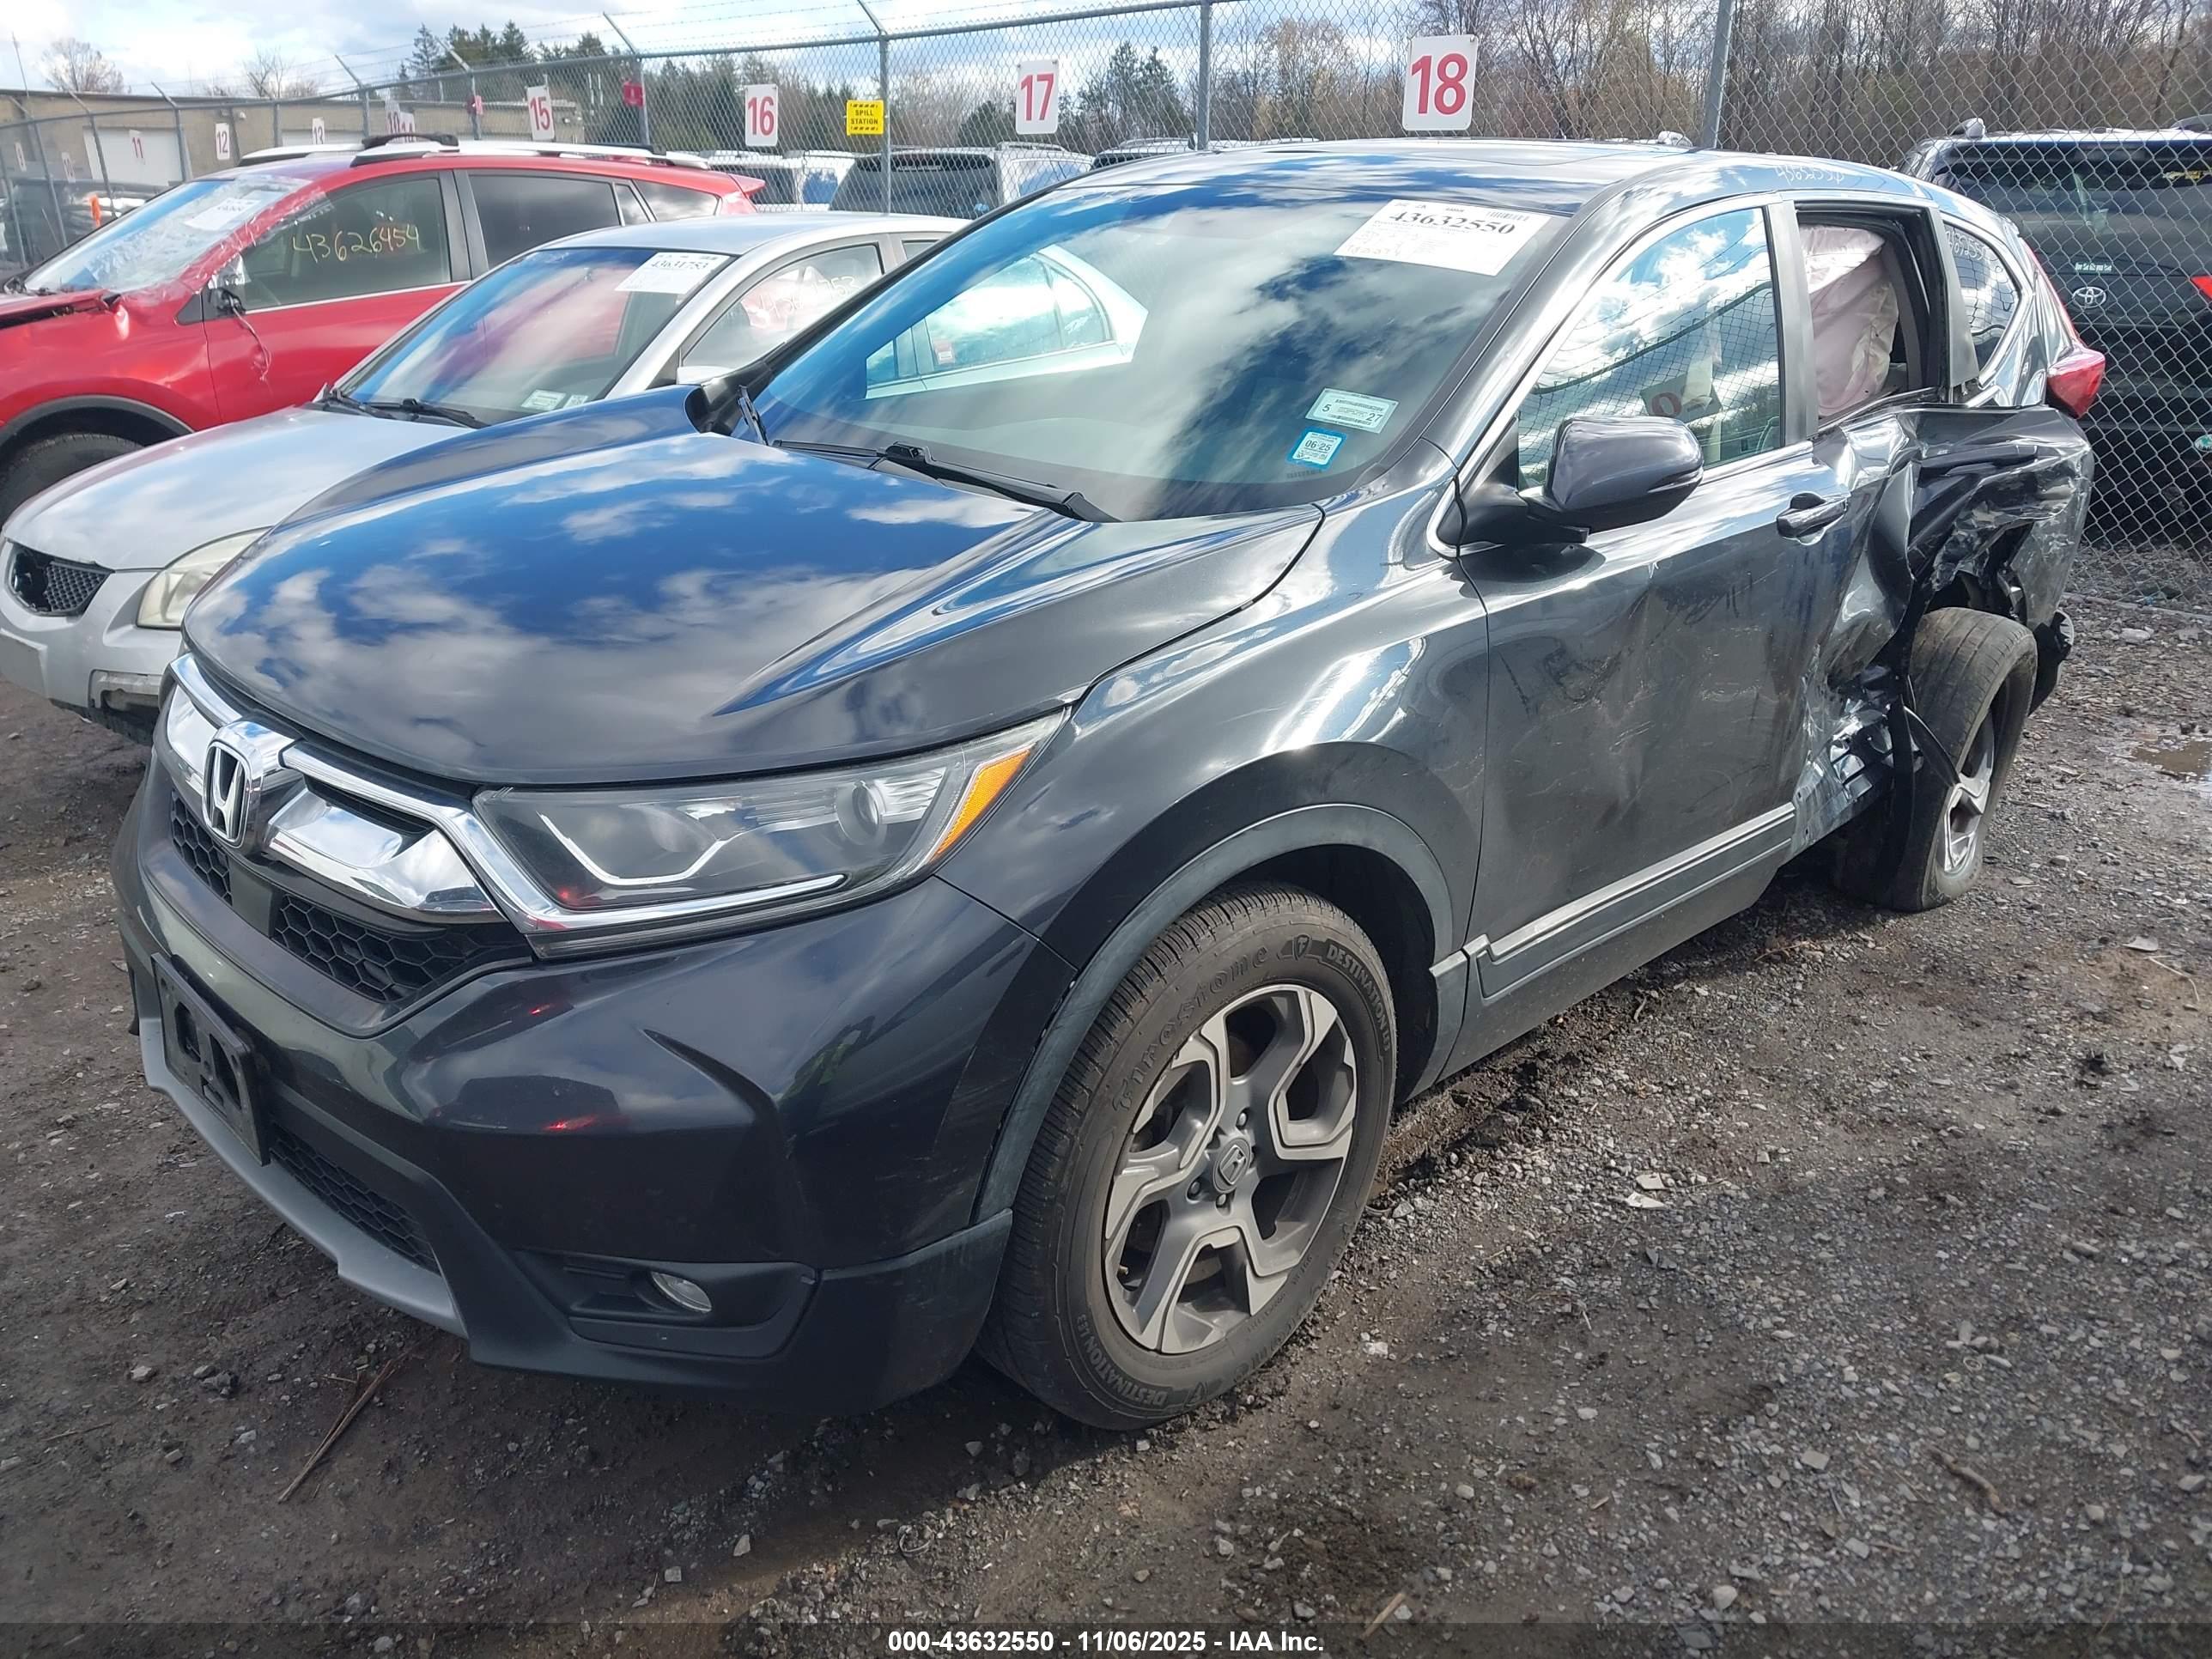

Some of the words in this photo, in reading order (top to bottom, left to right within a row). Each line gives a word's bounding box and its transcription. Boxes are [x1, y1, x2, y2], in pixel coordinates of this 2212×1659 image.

[1019, 73, 1055, 122] 17
[1411, 52, 1469, 116] 18
[528, 95, 550, 131] 15
[747, 95, 775, 137] 16
[131, 137, 144, 159] 11
[216, 131, 228, 155] 12
[1389, 211, 1516, 235] 43632550
[293, 224, 421, 264] 43626454
[1322, 404, 1332, 412] 5
[1365, 412, 1383, 423] 27
[1326, 943, 1388, 1030] DESTINATION
[1084, 1336, 1169, 1407] DESTINATION
